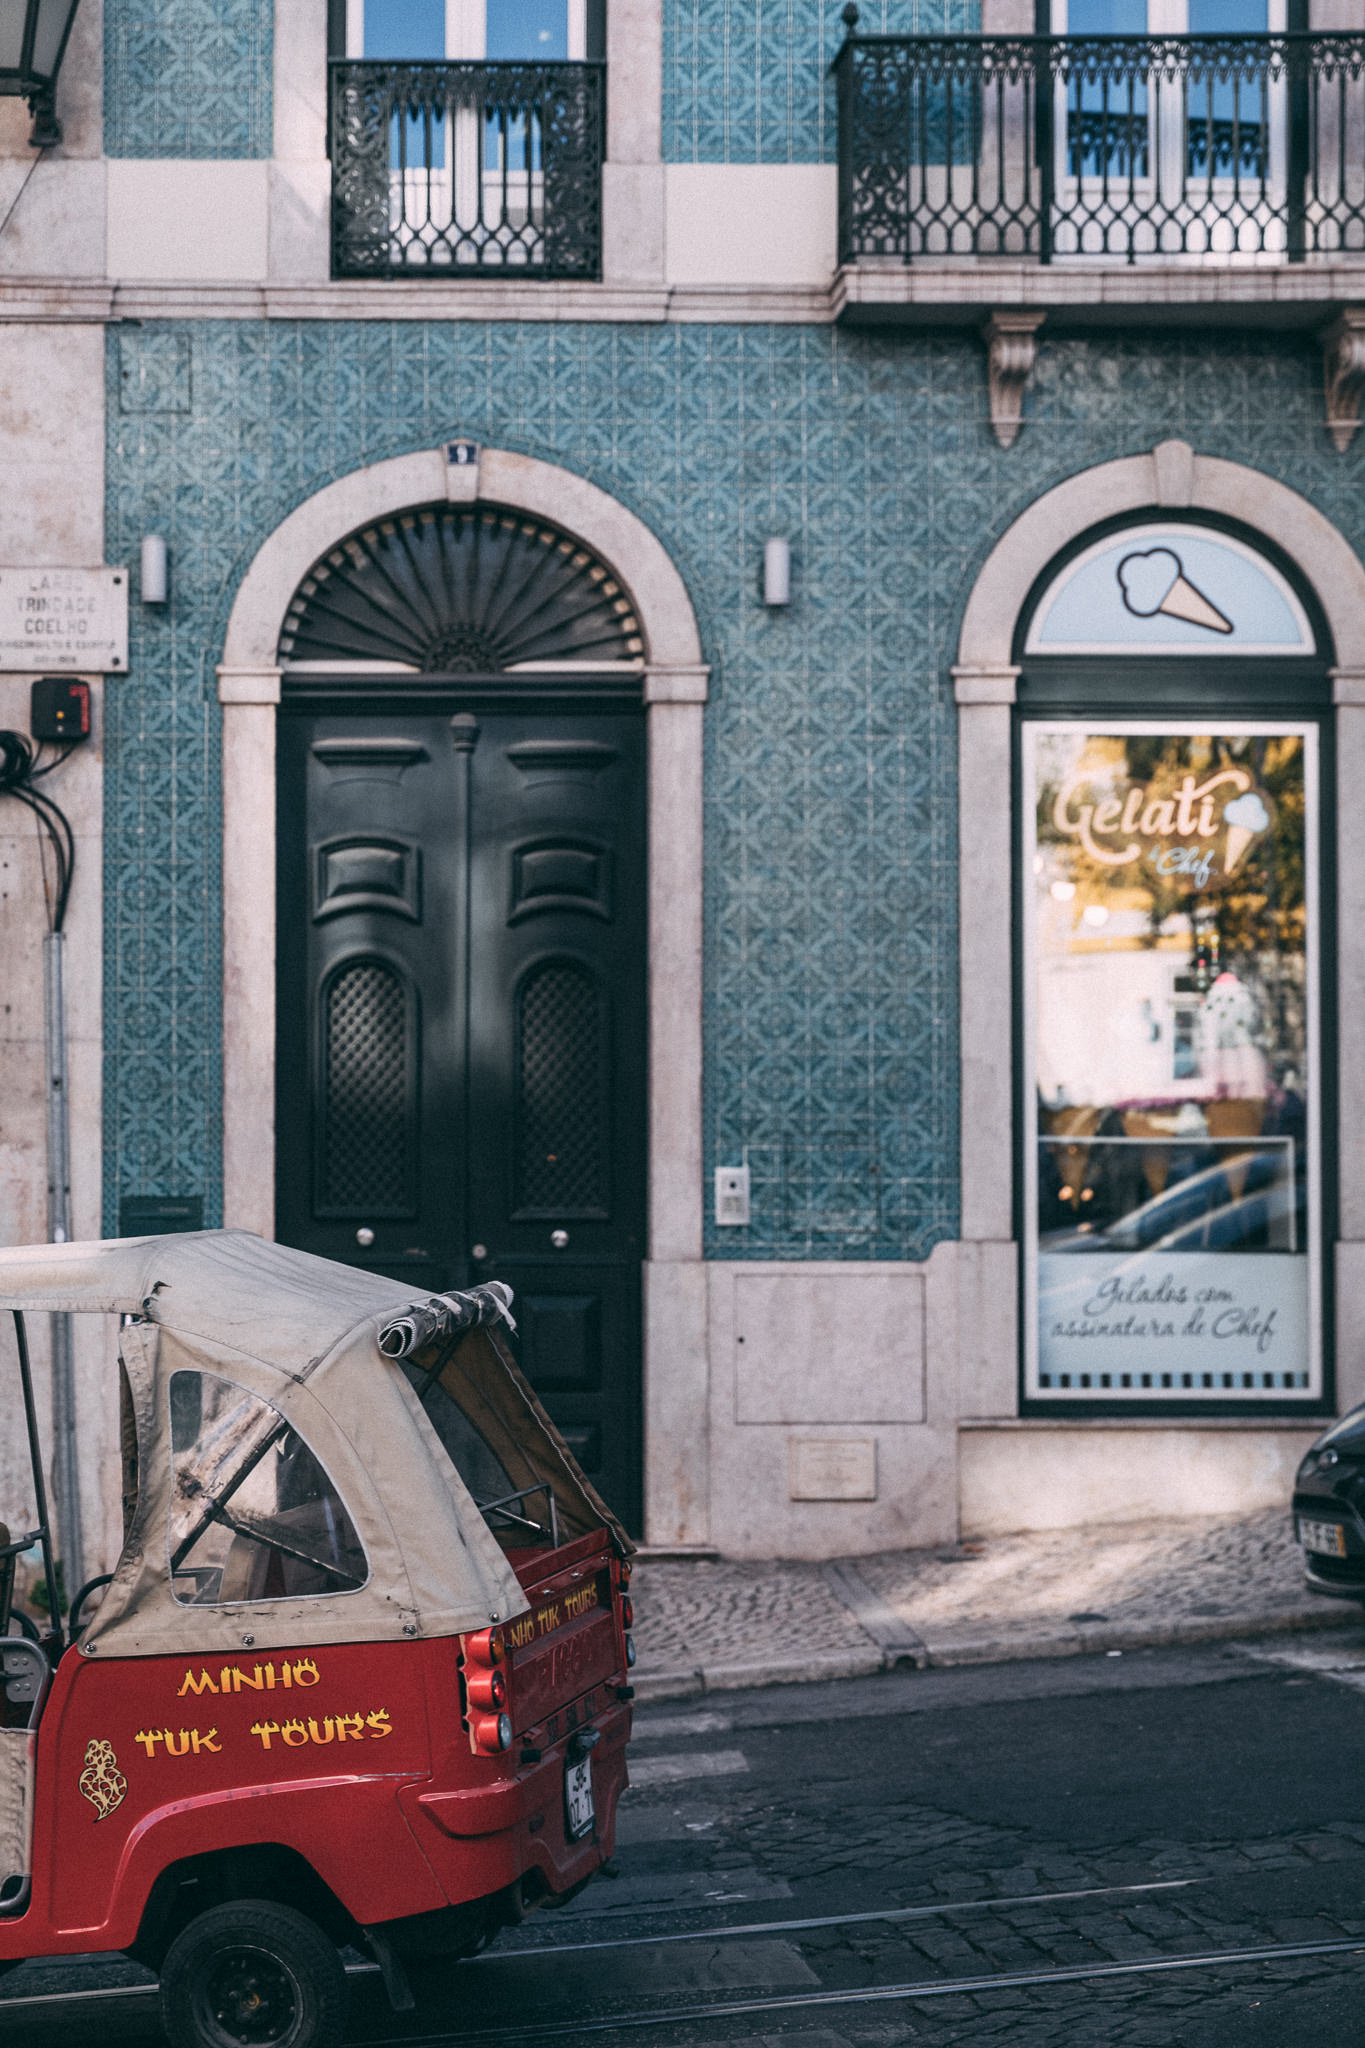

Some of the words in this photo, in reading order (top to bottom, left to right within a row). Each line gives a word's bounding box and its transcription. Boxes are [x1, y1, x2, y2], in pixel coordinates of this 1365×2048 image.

[24, 617, 88, 635] COELHO
[1053, 769, 1250, 865] Gelati
[1082, 1272, 1188, 1317] Gelados
[1050, 1315, 1176, 1338] assinatura
[1181, 1306, 1207, 1338] de
[1211, 1306, 1279, 1354] Chef
[510, 1613, 535, 1648] NHO
[537, 1604, 560, 1635] TUK
[565, 1579, 599, 1621] TOURS
[176, 1657, 321, 1697] MINHO
[134, 1725, 223, 1759] TUK
[250, 1706, 393, 1751] TOURS
